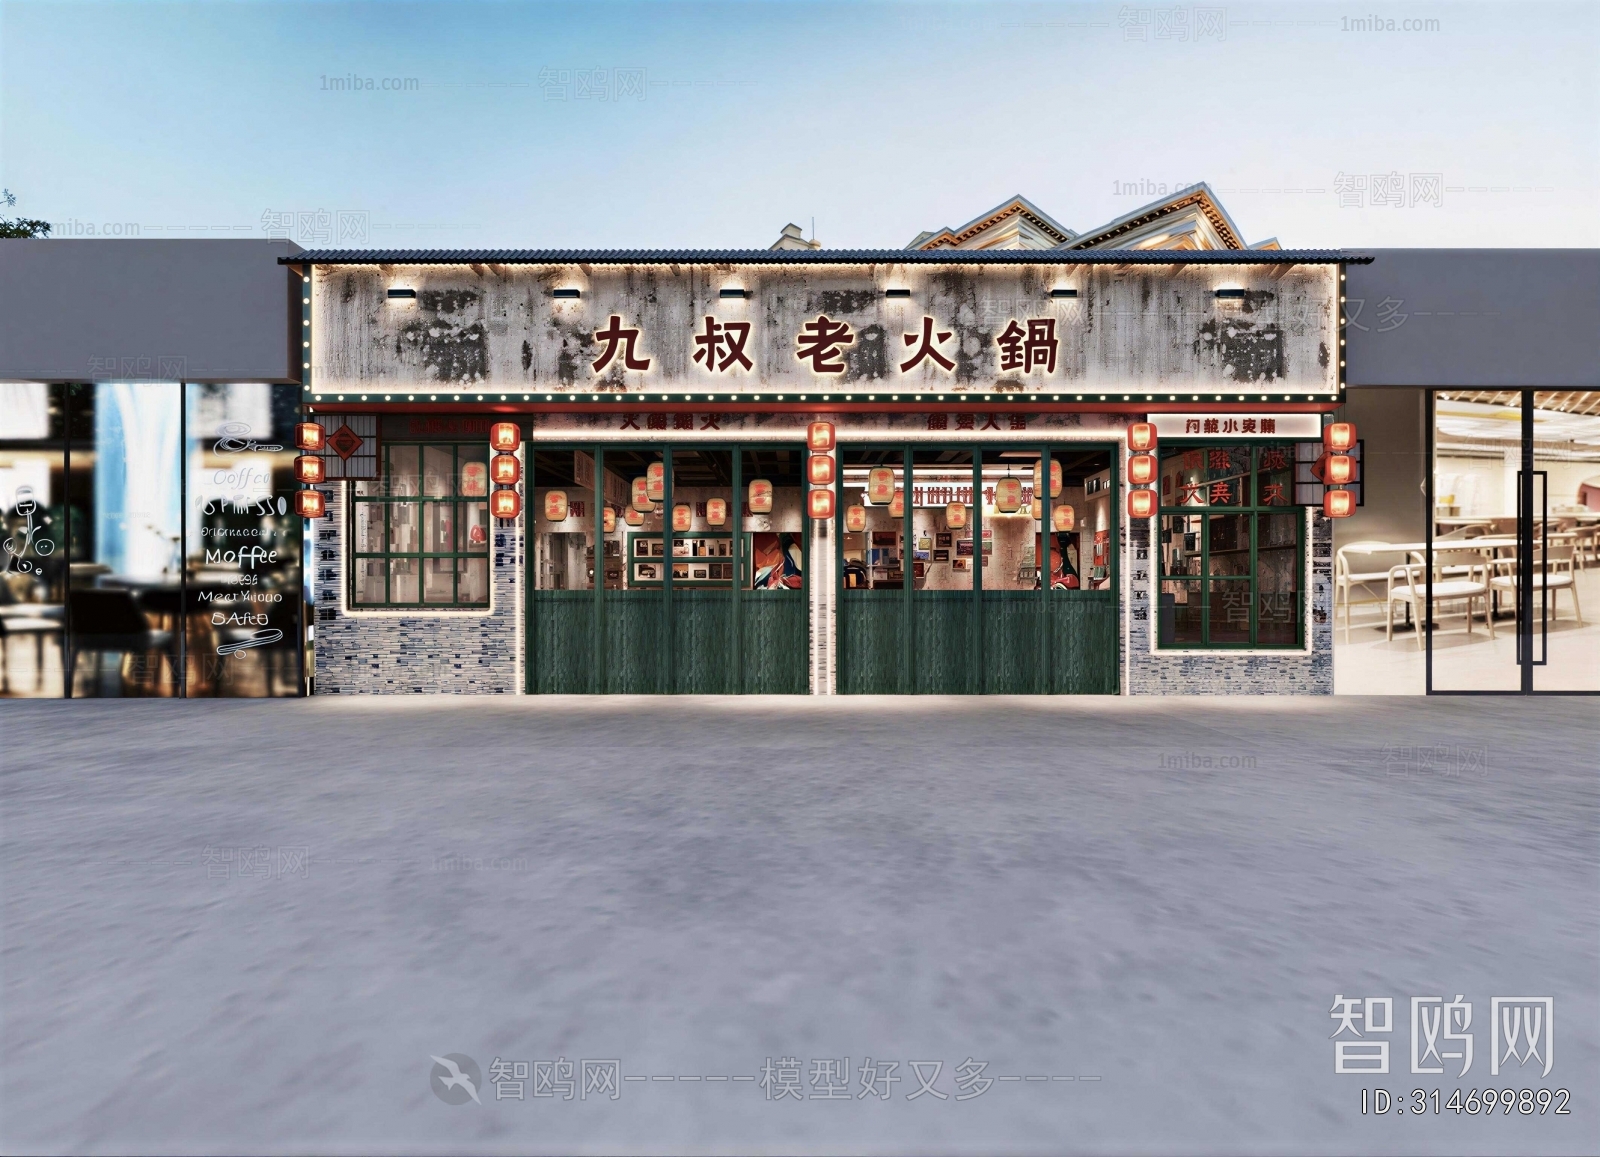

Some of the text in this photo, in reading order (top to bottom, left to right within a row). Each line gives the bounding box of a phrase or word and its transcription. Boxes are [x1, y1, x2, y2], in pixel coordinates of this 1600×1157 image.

[591, 315, 1060, 375] 九叔老火鍋
[205, 545, 278, 570] Moffee
